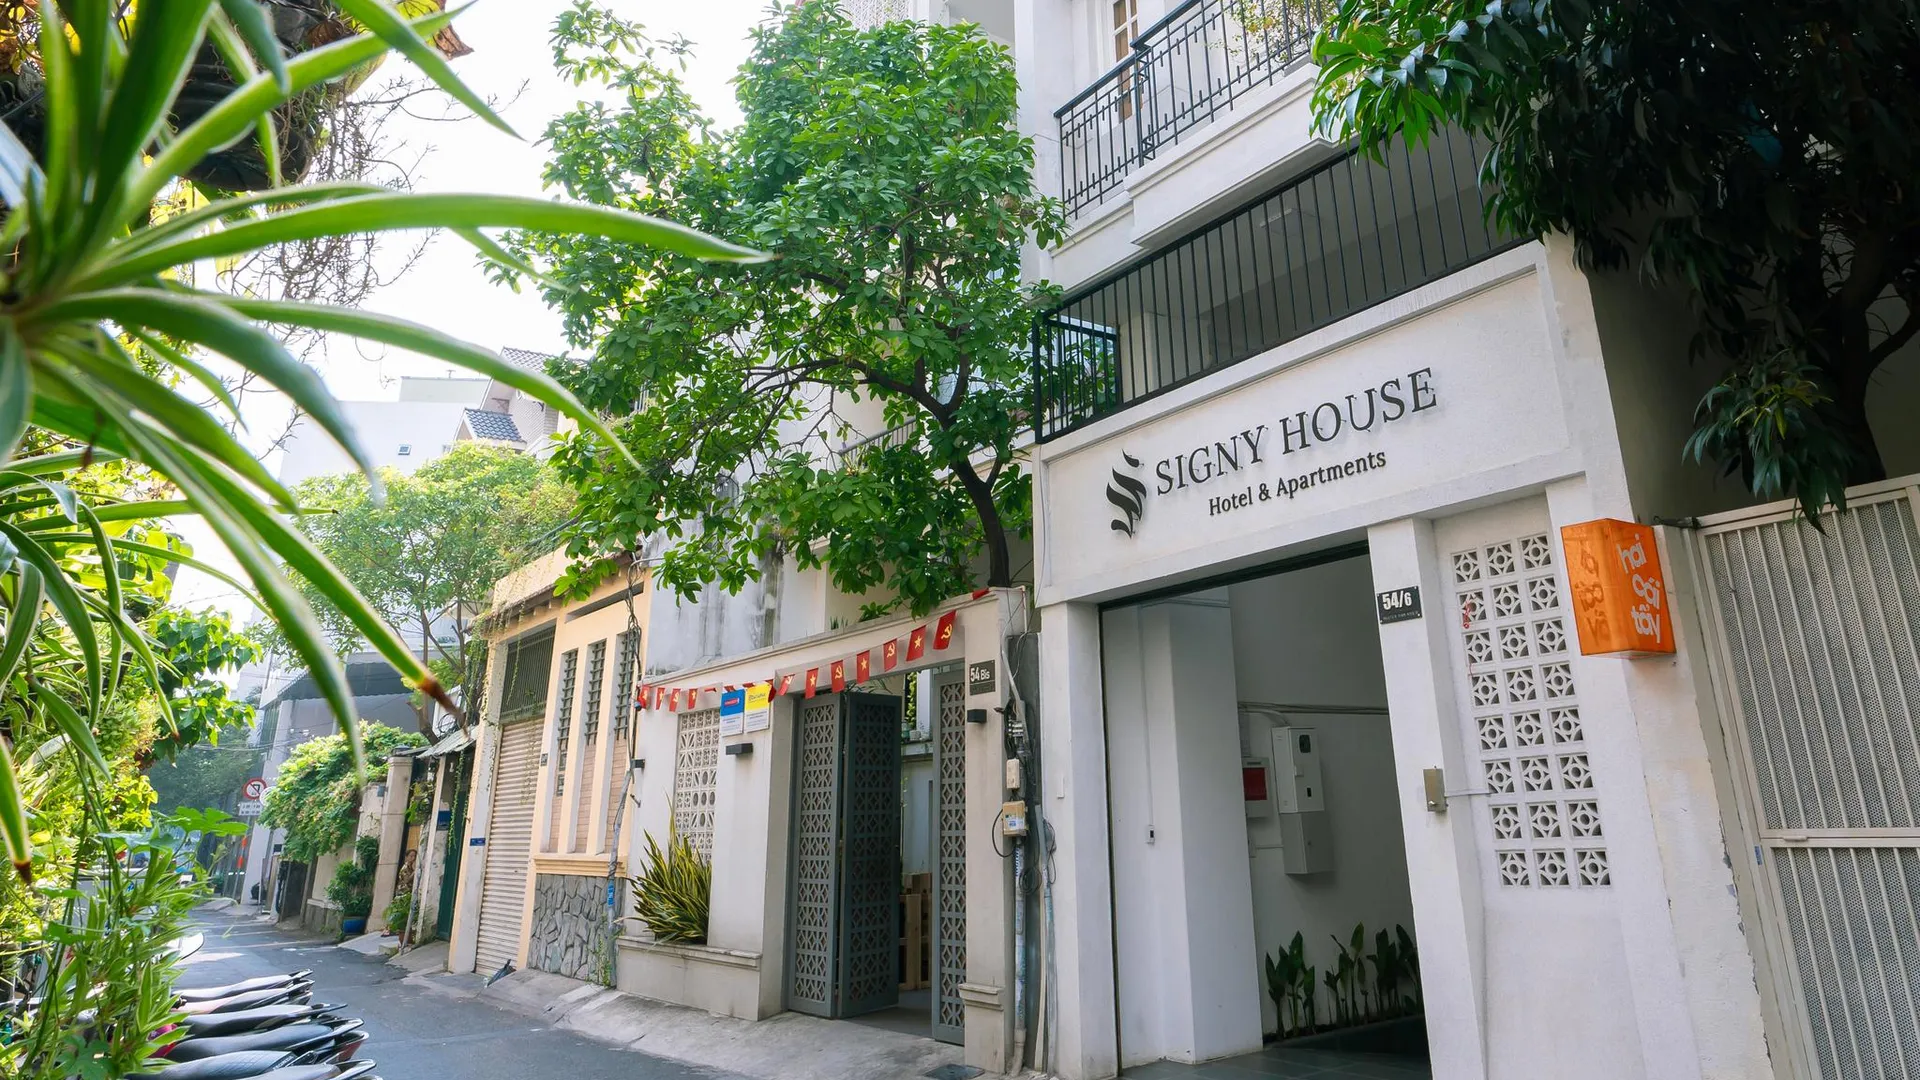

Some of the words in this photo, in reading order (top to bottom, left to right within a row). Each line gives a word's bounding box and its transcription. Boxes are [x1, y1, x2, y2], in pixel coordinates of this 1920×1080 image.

[1156, 425, 1268, 496] SIGNY
[1279, 367, 1437, 455] HOUSE
[1209, 487, 1253, 516] Hotel
[1258, 483, 1271, 501] &
[1276, 452, 1387, 499] Apartments
[1616, 533, 1647, 573] hai
[1382, 590, 1412, 610] 54/6
[970, 667, 980, 682] 54
[980, 669, 990, 681] Bis
